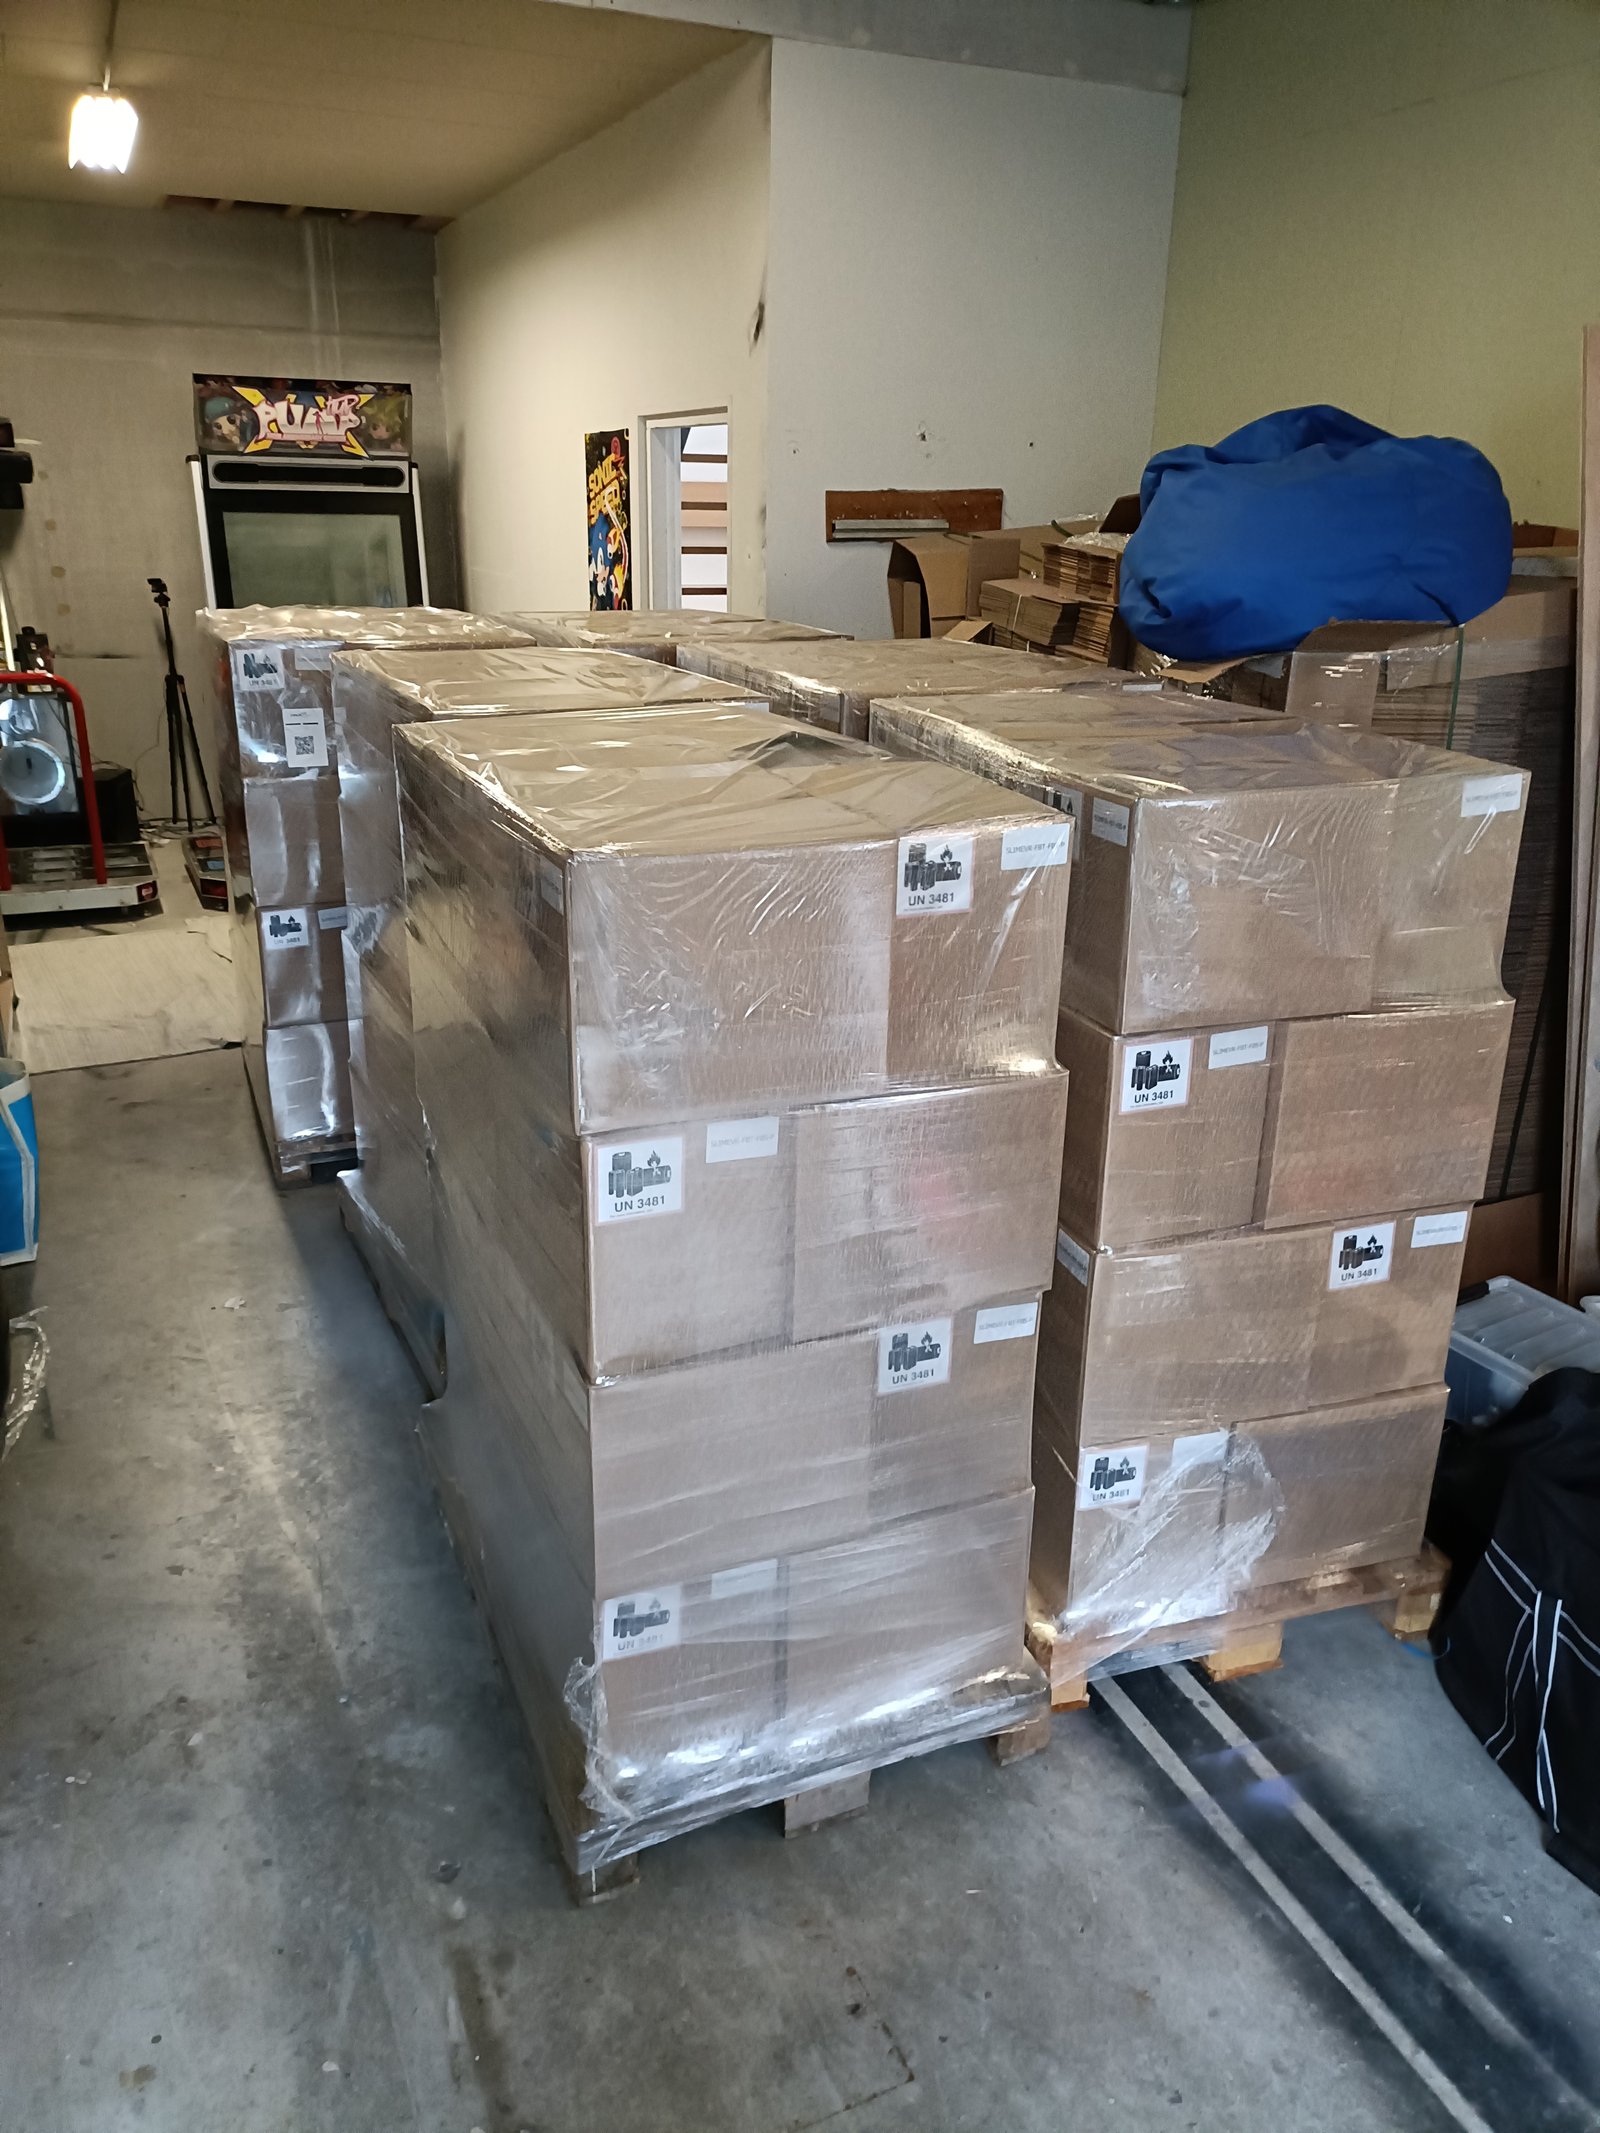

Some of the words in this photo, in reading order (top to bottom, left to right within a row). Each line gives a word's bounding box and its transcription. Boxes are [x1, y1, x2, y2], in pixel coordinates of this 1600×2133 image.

[588, 453, 617, 500] SONIC
[908, 895, 926, 906] UN
[929, 892, 954, 905] 3481
[1134, 1094, 1149, 1104] UN
[1152, 1090, 1174, 1101] 3481
[614, 1200, 633, 1213] UN
[637, 1195, 666, 1209] 3481
[1341, 1272, 1354, 1282] UN
[1357, 1268, 1377, 1279] 3481
[892, 1373, 908, 1385] UN
[911, 1369, 934, 1381] 3481
[1092, 1493, 1106, 1501] UN
[618, 1641, 635, 1651] UN
